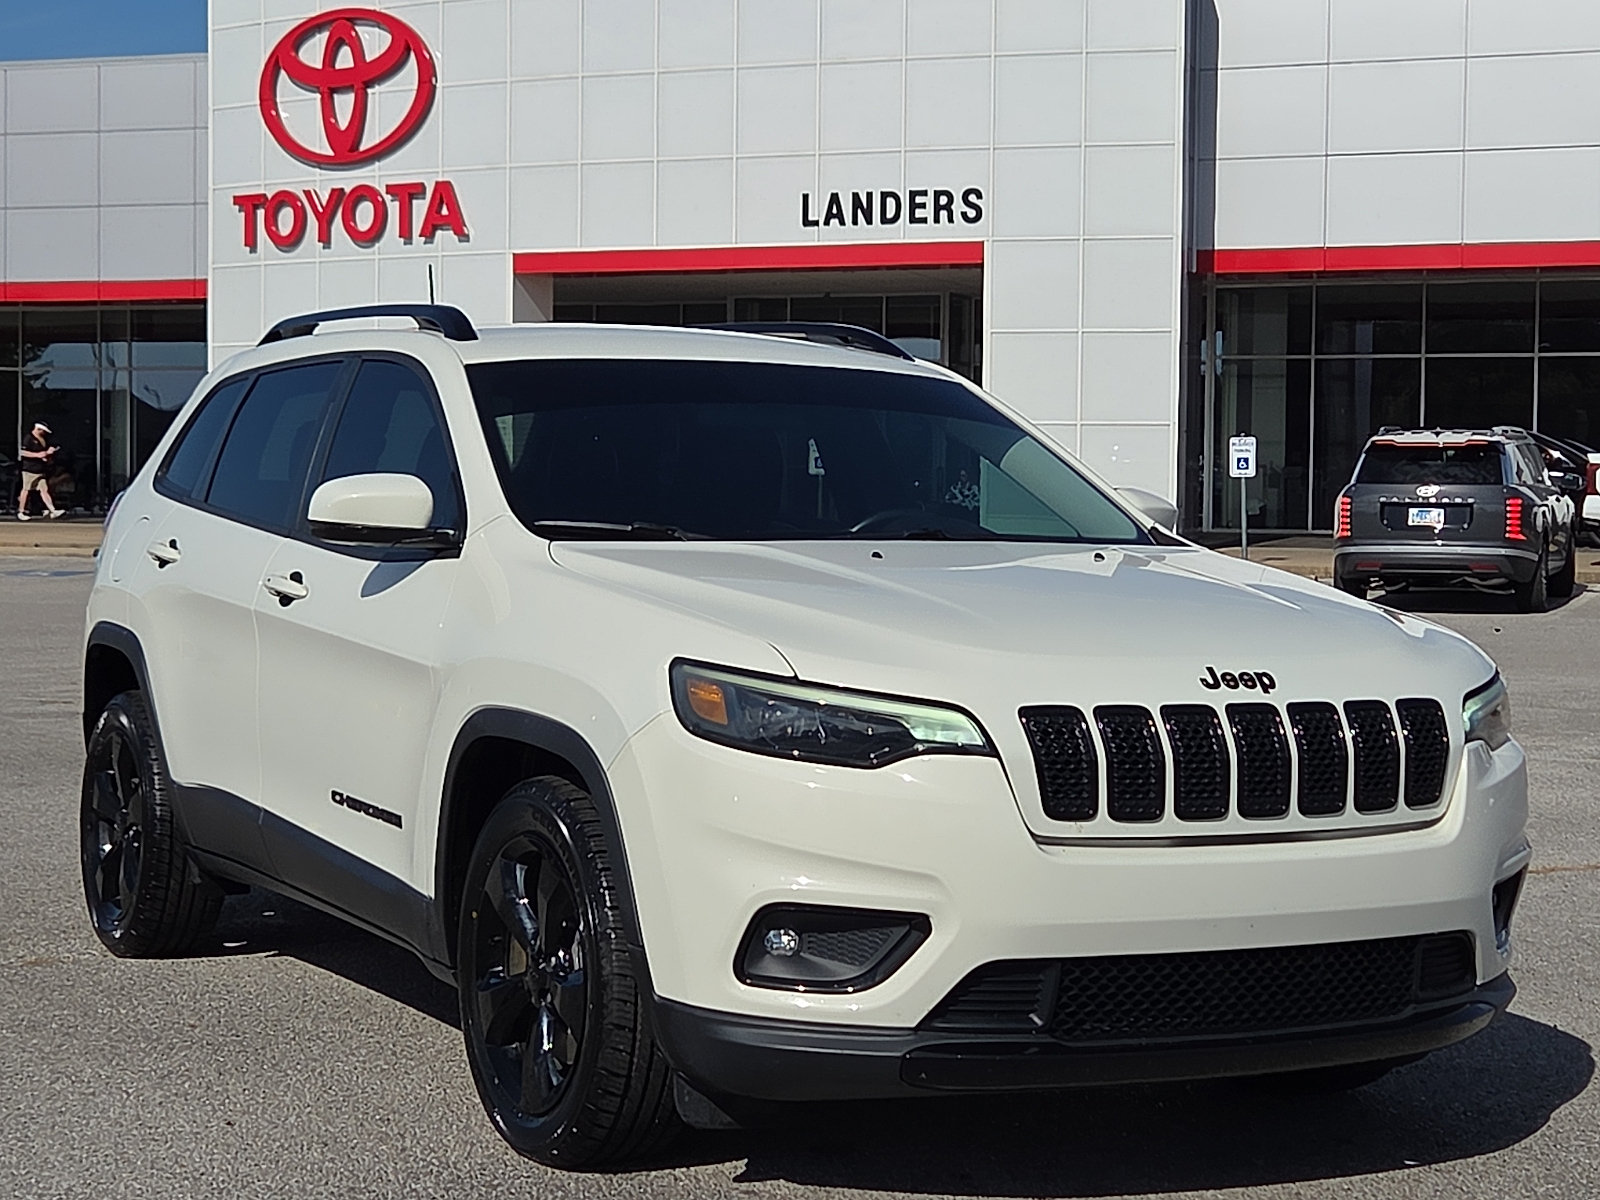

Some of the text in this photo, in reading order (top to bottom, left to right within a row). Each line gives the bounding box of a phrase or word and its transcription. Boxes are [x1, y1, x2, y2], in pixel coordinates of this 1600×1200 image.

[233, 181, 469, 251] TOYOTA
[801, 188, 984, 228] LANDERS
[1199, 666, 1277, 695] Jeep
[331, 789, 403, 830] CHOK
